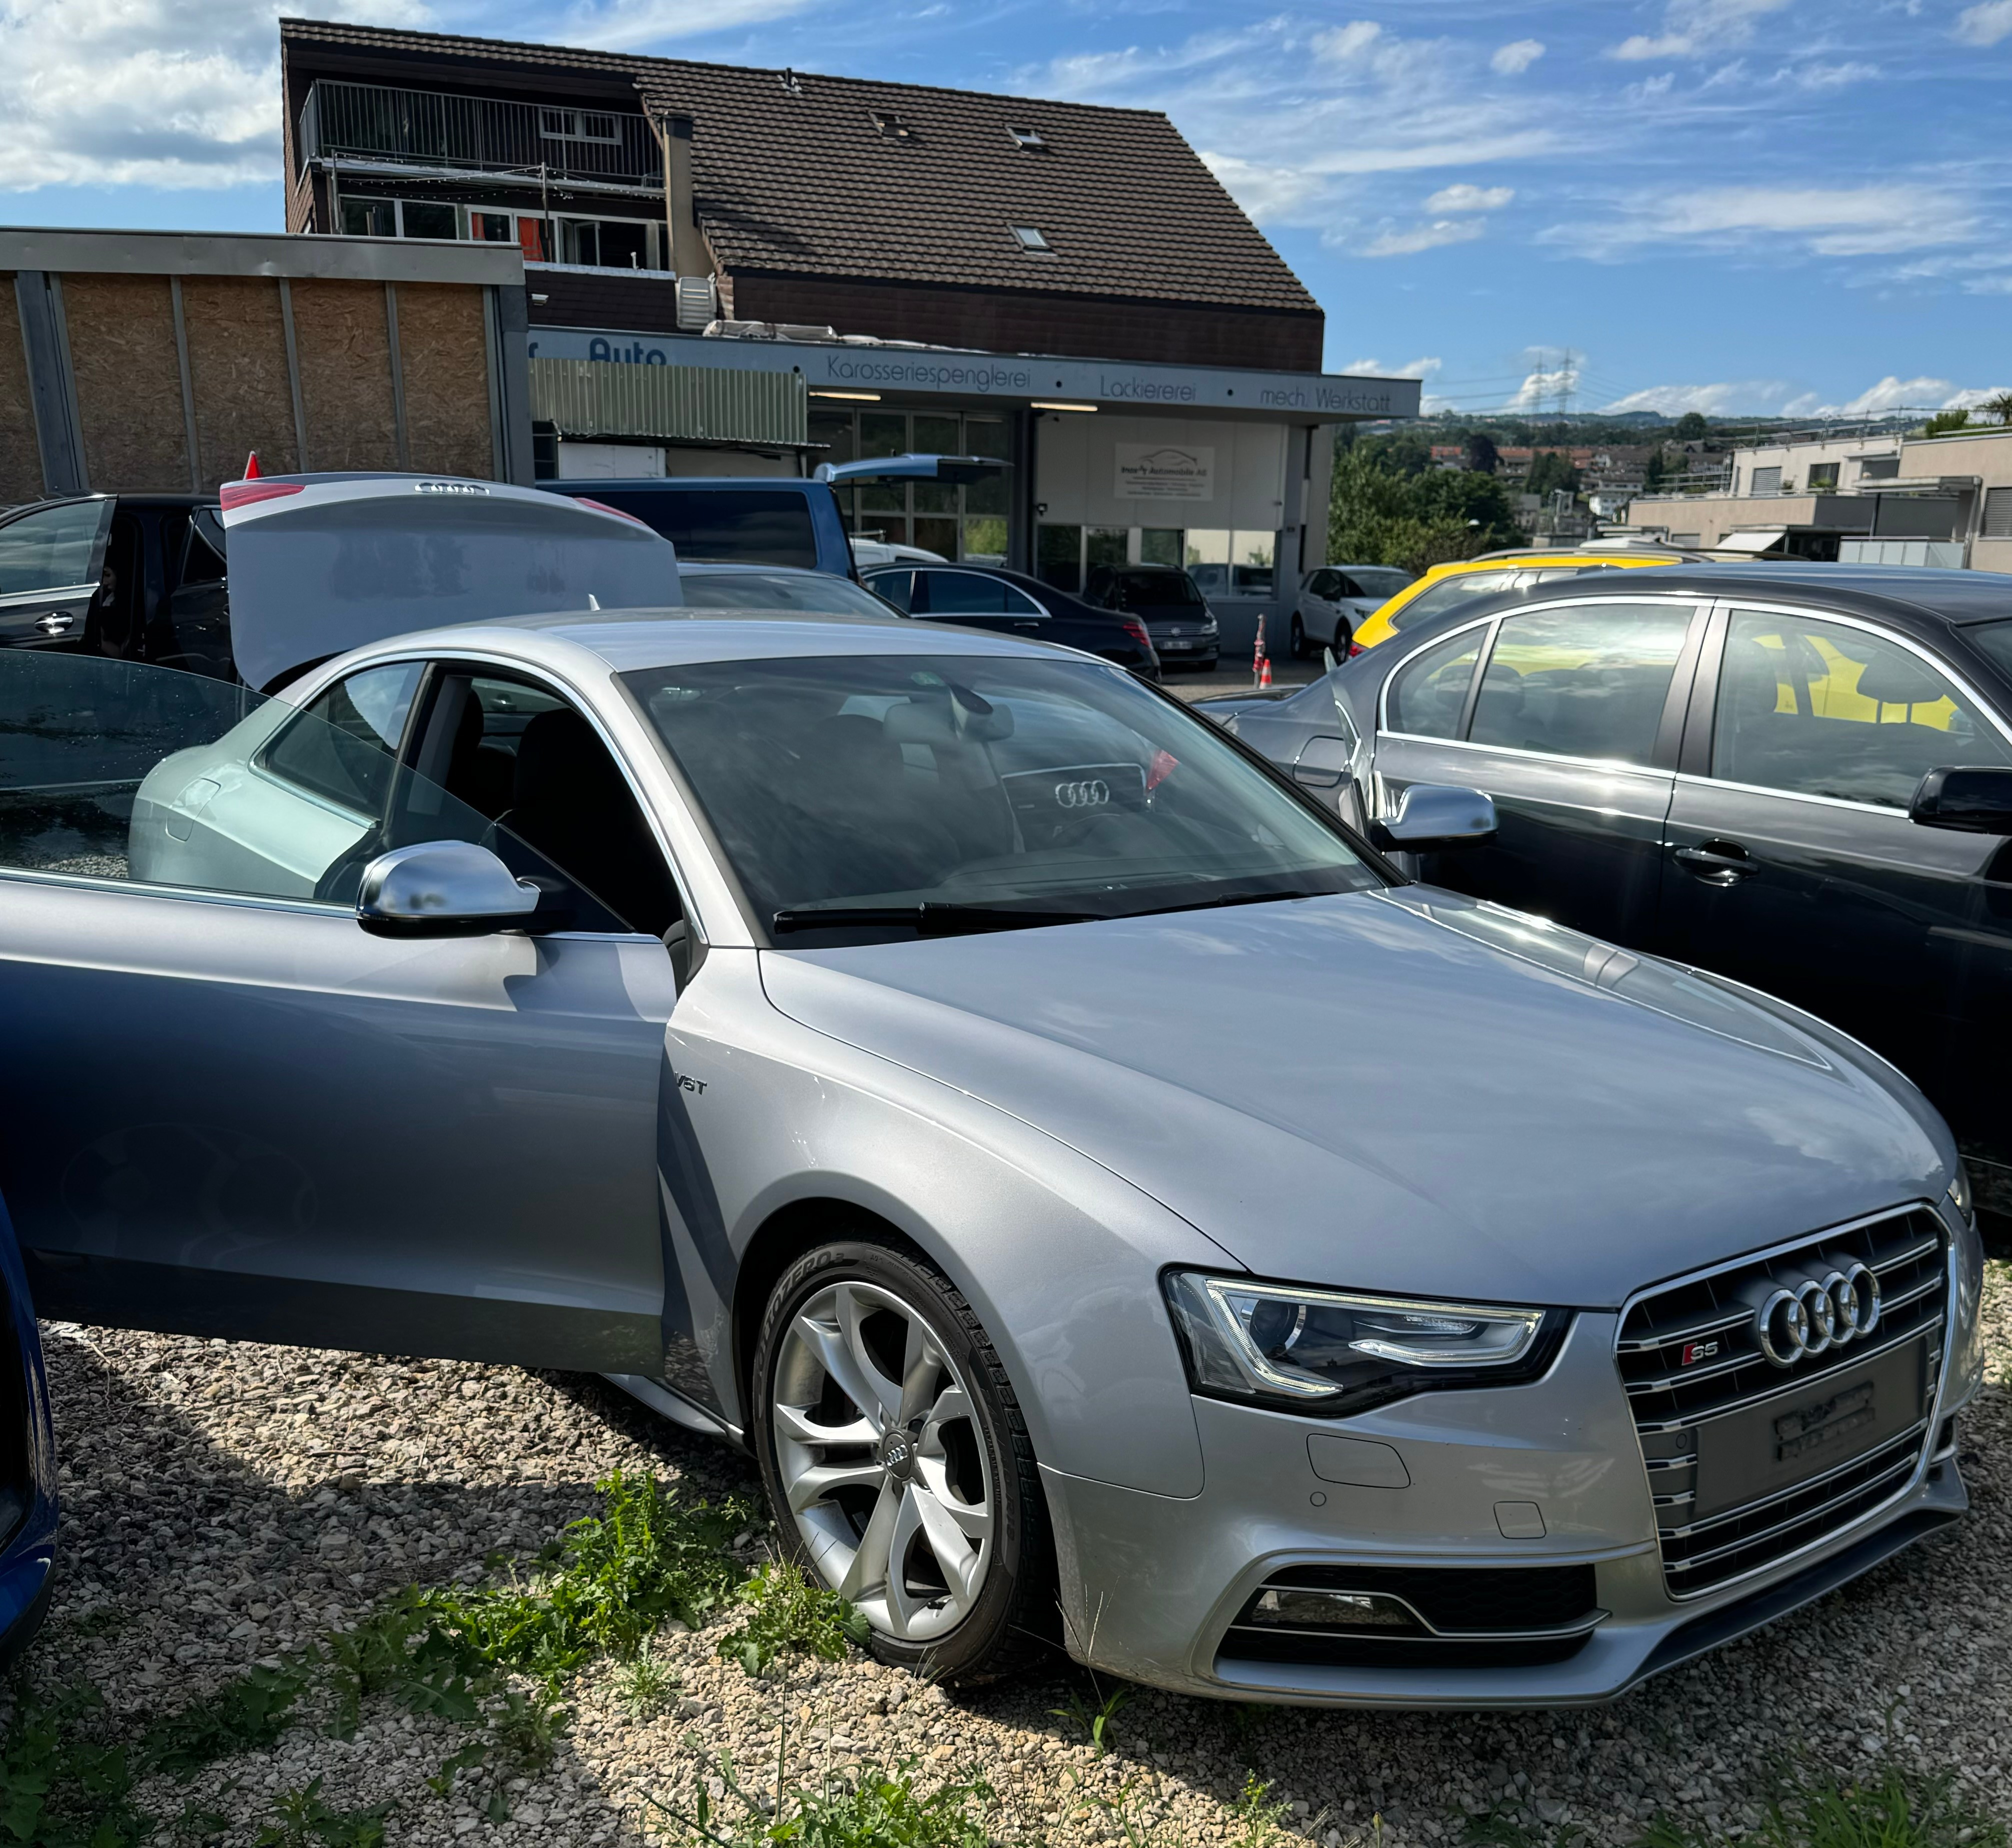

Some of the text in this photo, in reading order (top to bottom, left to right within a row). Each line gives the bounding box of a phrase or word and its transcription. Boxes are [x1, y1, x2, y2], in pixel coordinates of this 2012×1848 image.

[590, 337, 667, 366] Auto
[827, 356, 1391, 412] Karosseriespenglerei Lackiererei mech. Werkstatt
[1690, 1341, 1718, 1360] S5
